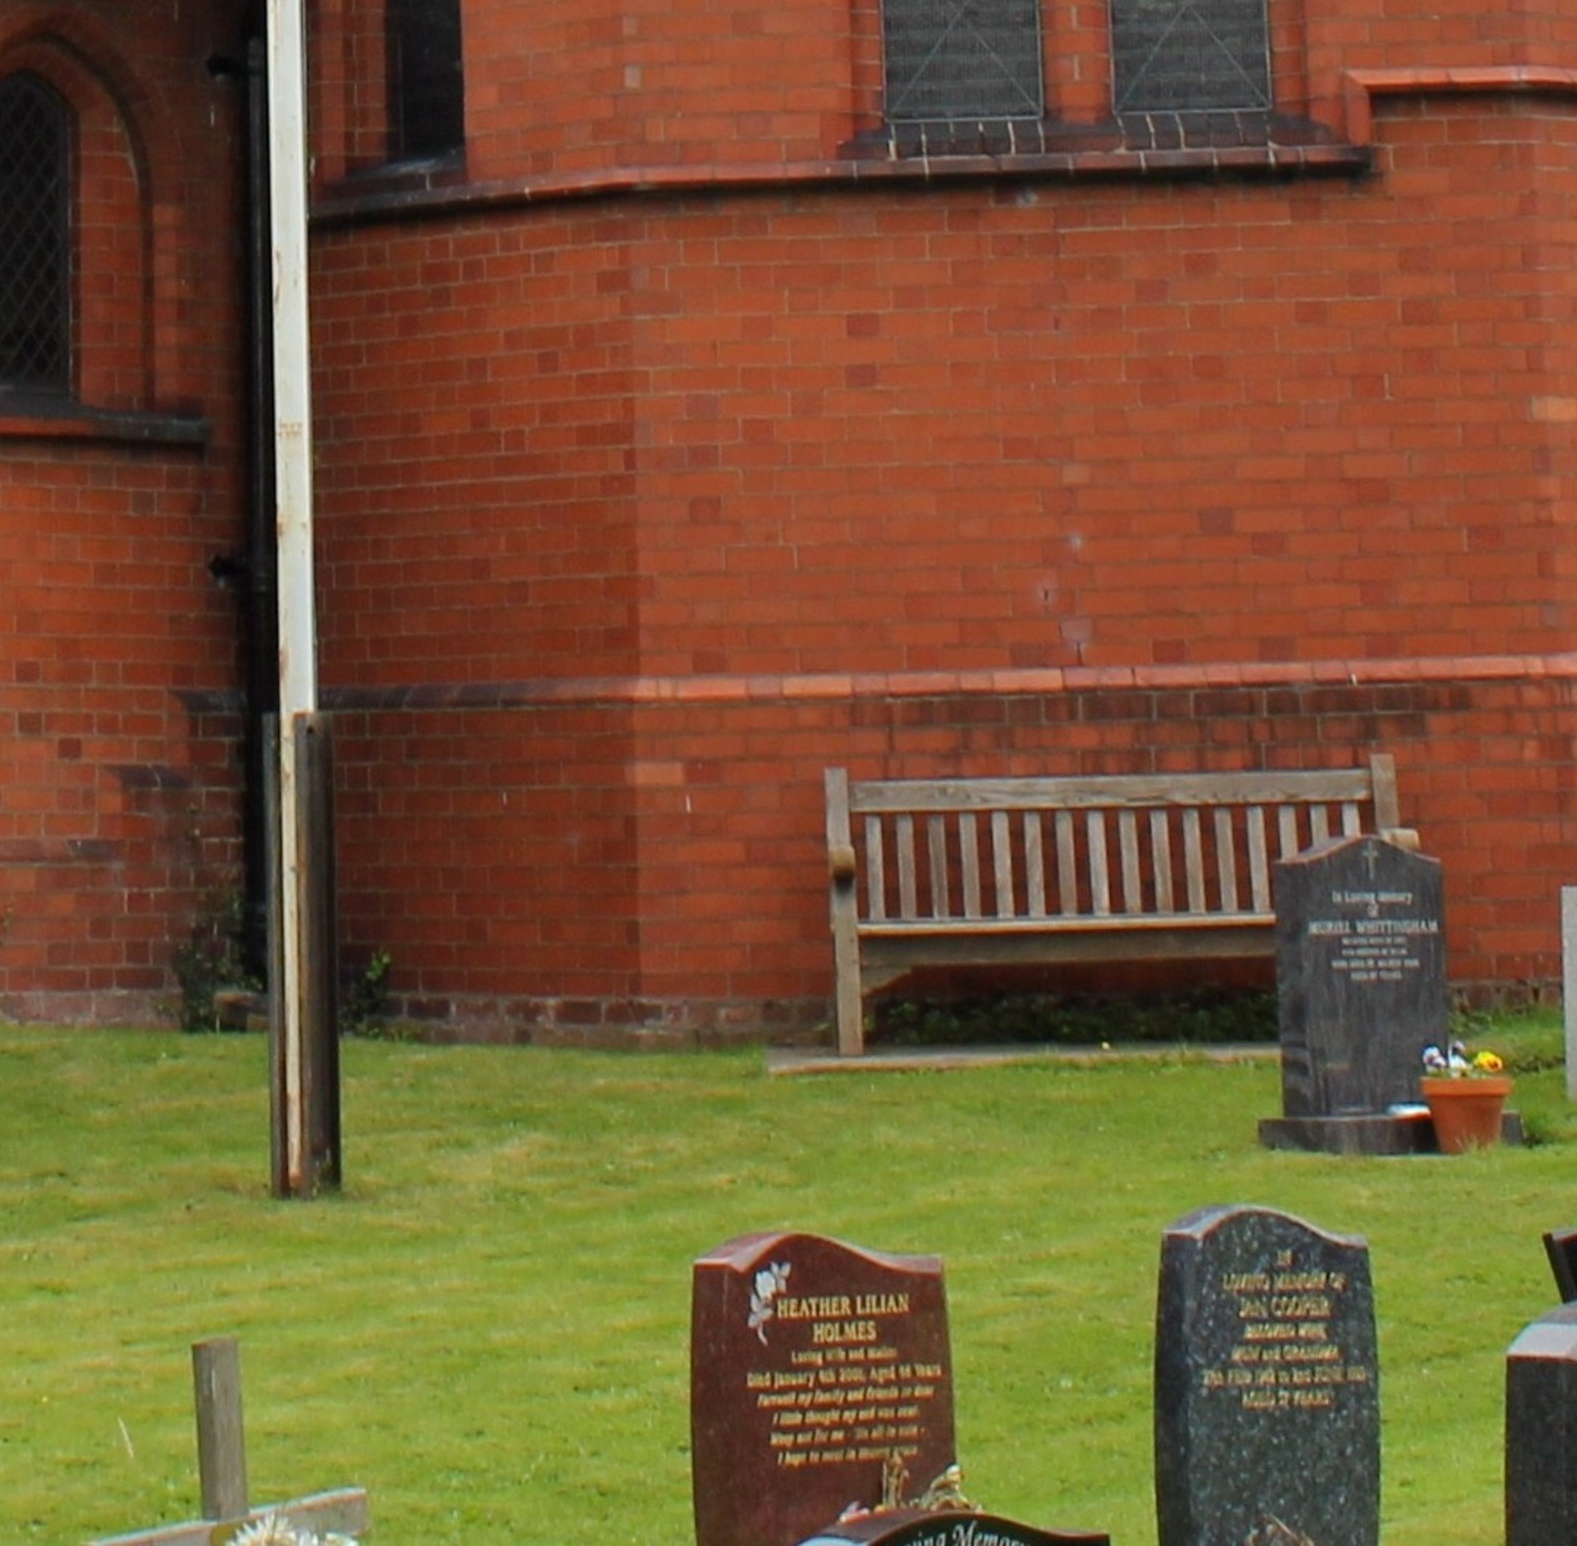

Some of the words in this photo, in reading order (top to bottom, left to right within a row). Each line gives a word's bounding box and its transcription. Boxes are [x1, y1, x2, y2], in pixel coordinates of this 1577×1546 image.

[1355, 920, 1438, 935] WHITTINGHAM
[1222, 1274, 1271, 1293] LOVING
[776, 1296, 852, 1319] HEATHER
[855, 1293, 910, 1315] LILIAN
[1271, 1296, 1332, 1318] COOPER
[813, 1320, 877, 1343] HOLMES
[791, 1350, 824, 1366] Loving
[774, 1370, 816, 1390] January
[869, 1365, 896, 1384] Aged
[913, 1362, 942, 1379] Years
[814, 1387, 846, 1406] family
